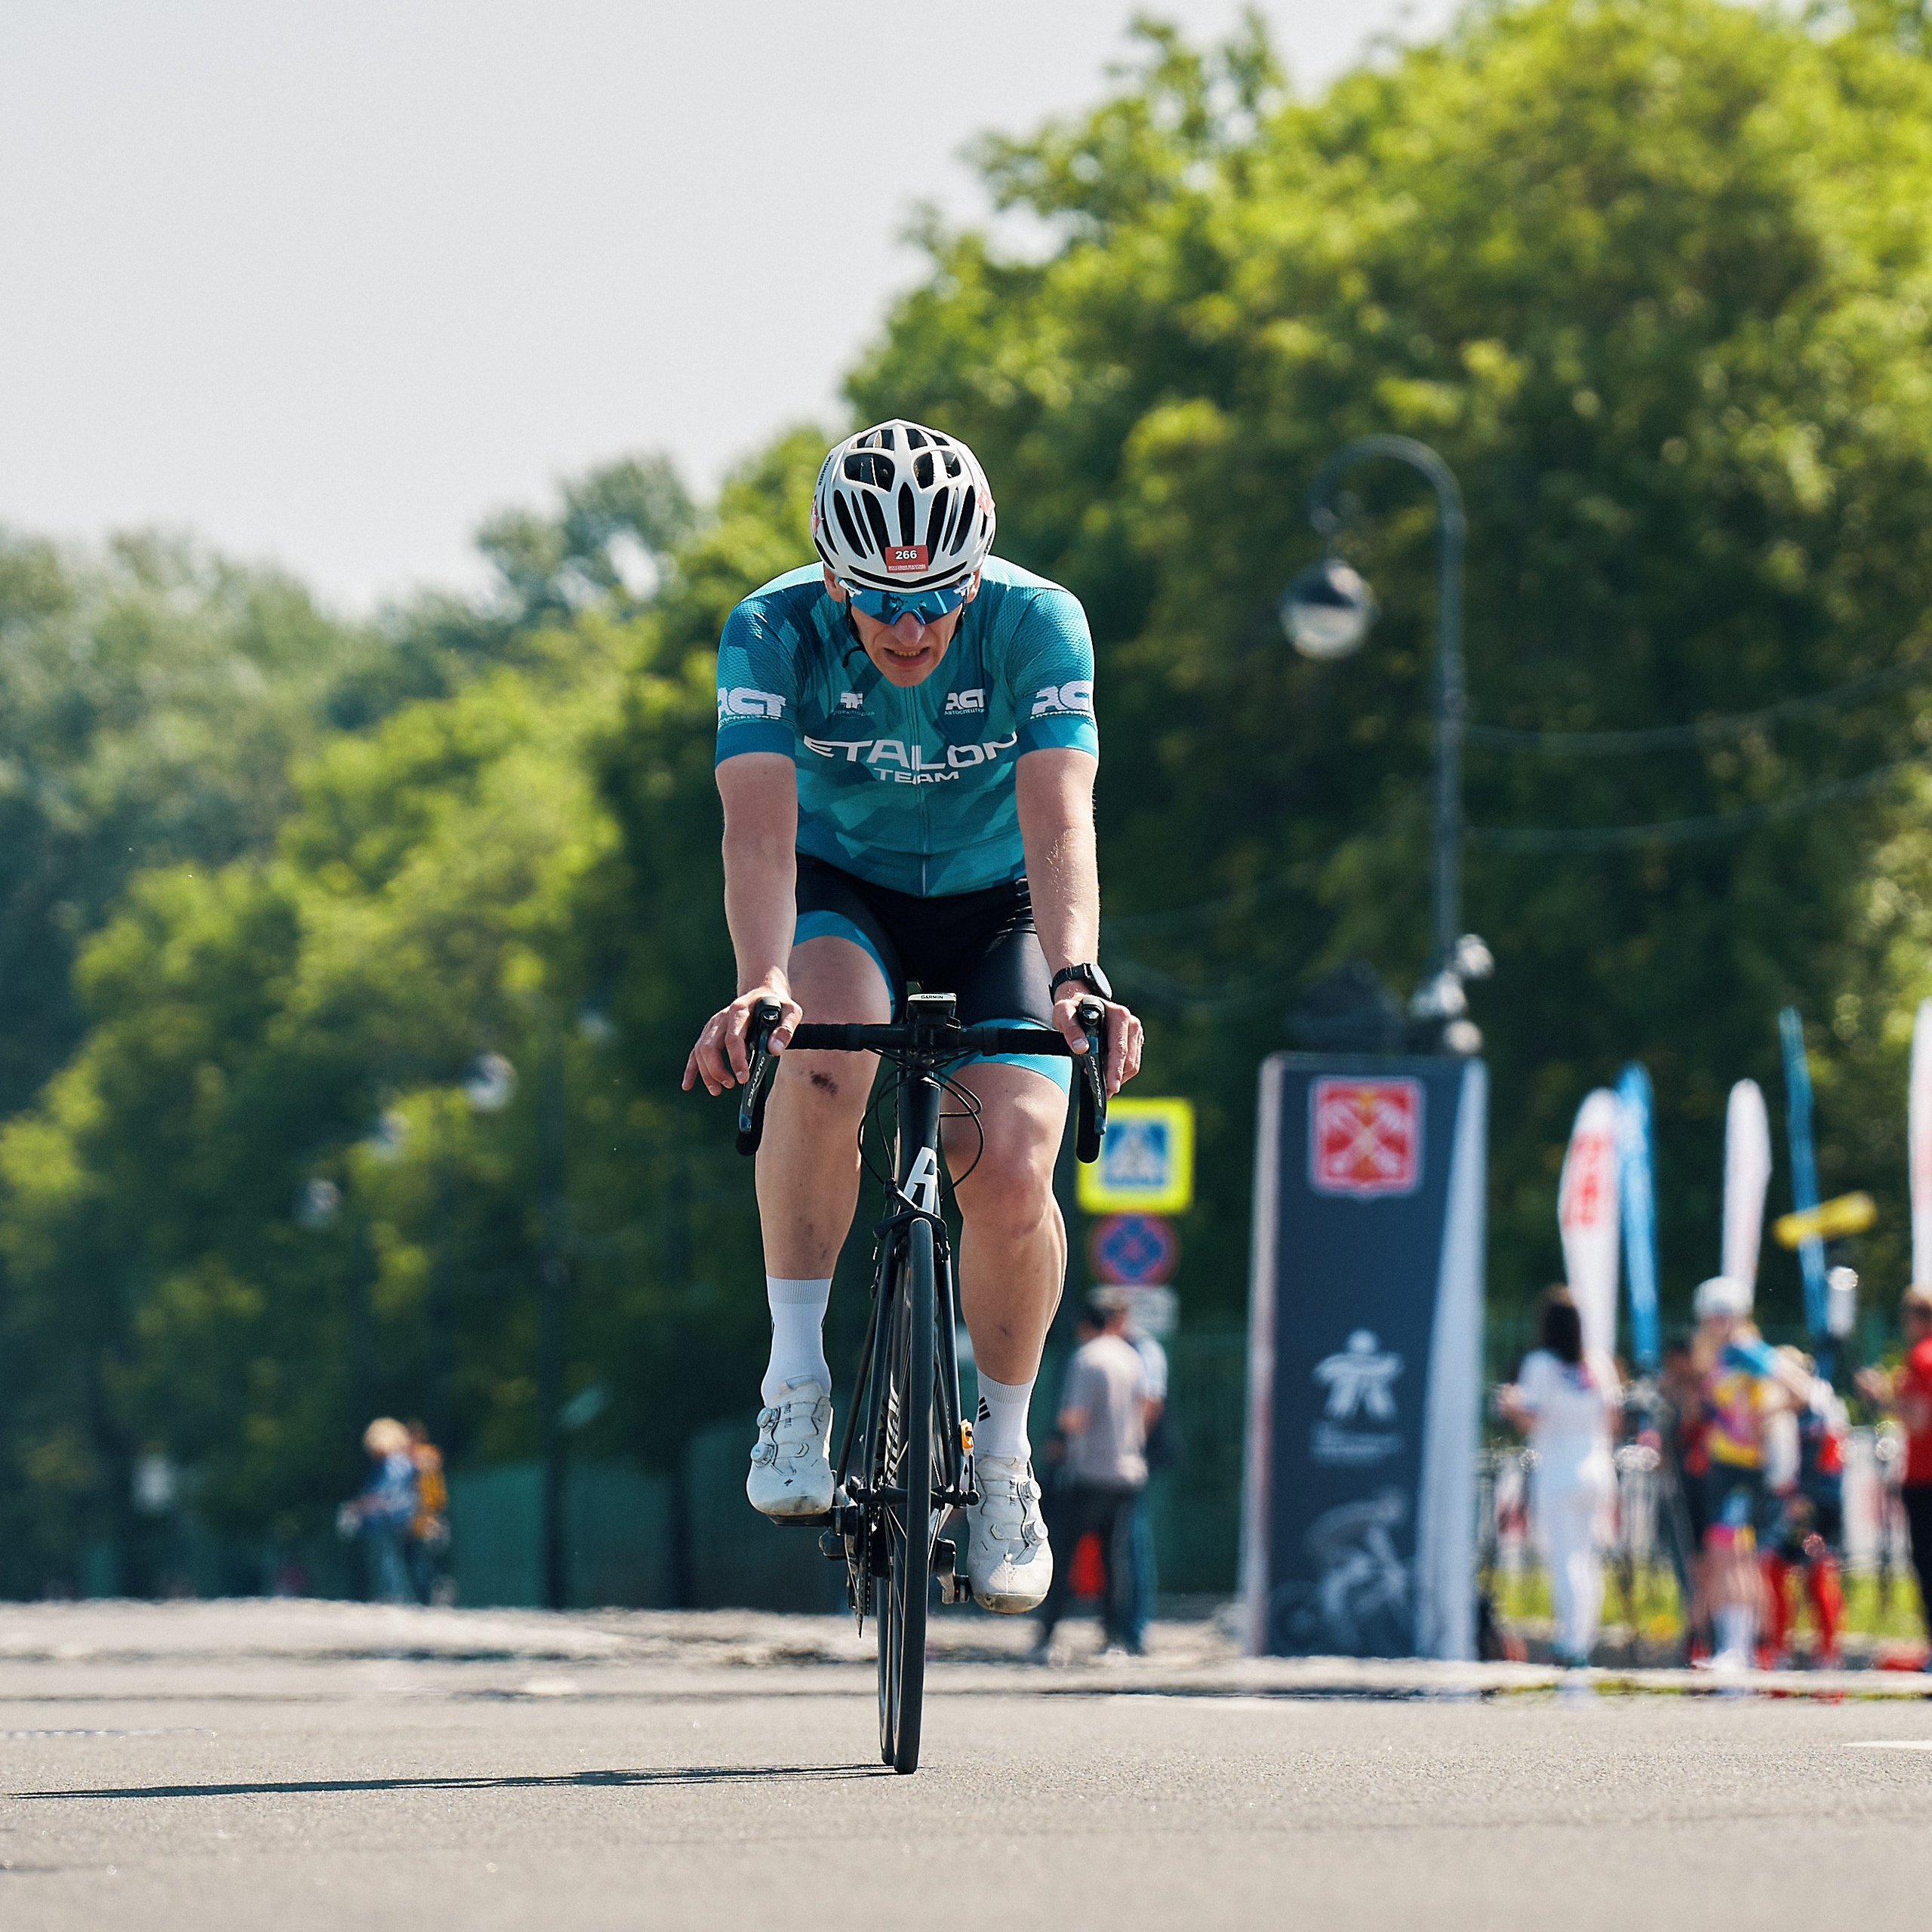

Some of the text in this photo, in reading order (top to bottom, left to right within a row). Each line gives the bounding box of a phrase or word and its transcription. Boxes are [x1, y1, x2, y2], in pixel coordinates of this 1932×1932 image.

[895, 549, 918, 560] 266
[803, 731, 1017, 771] ETALON
[873, 768, 959, 785] TEAM
